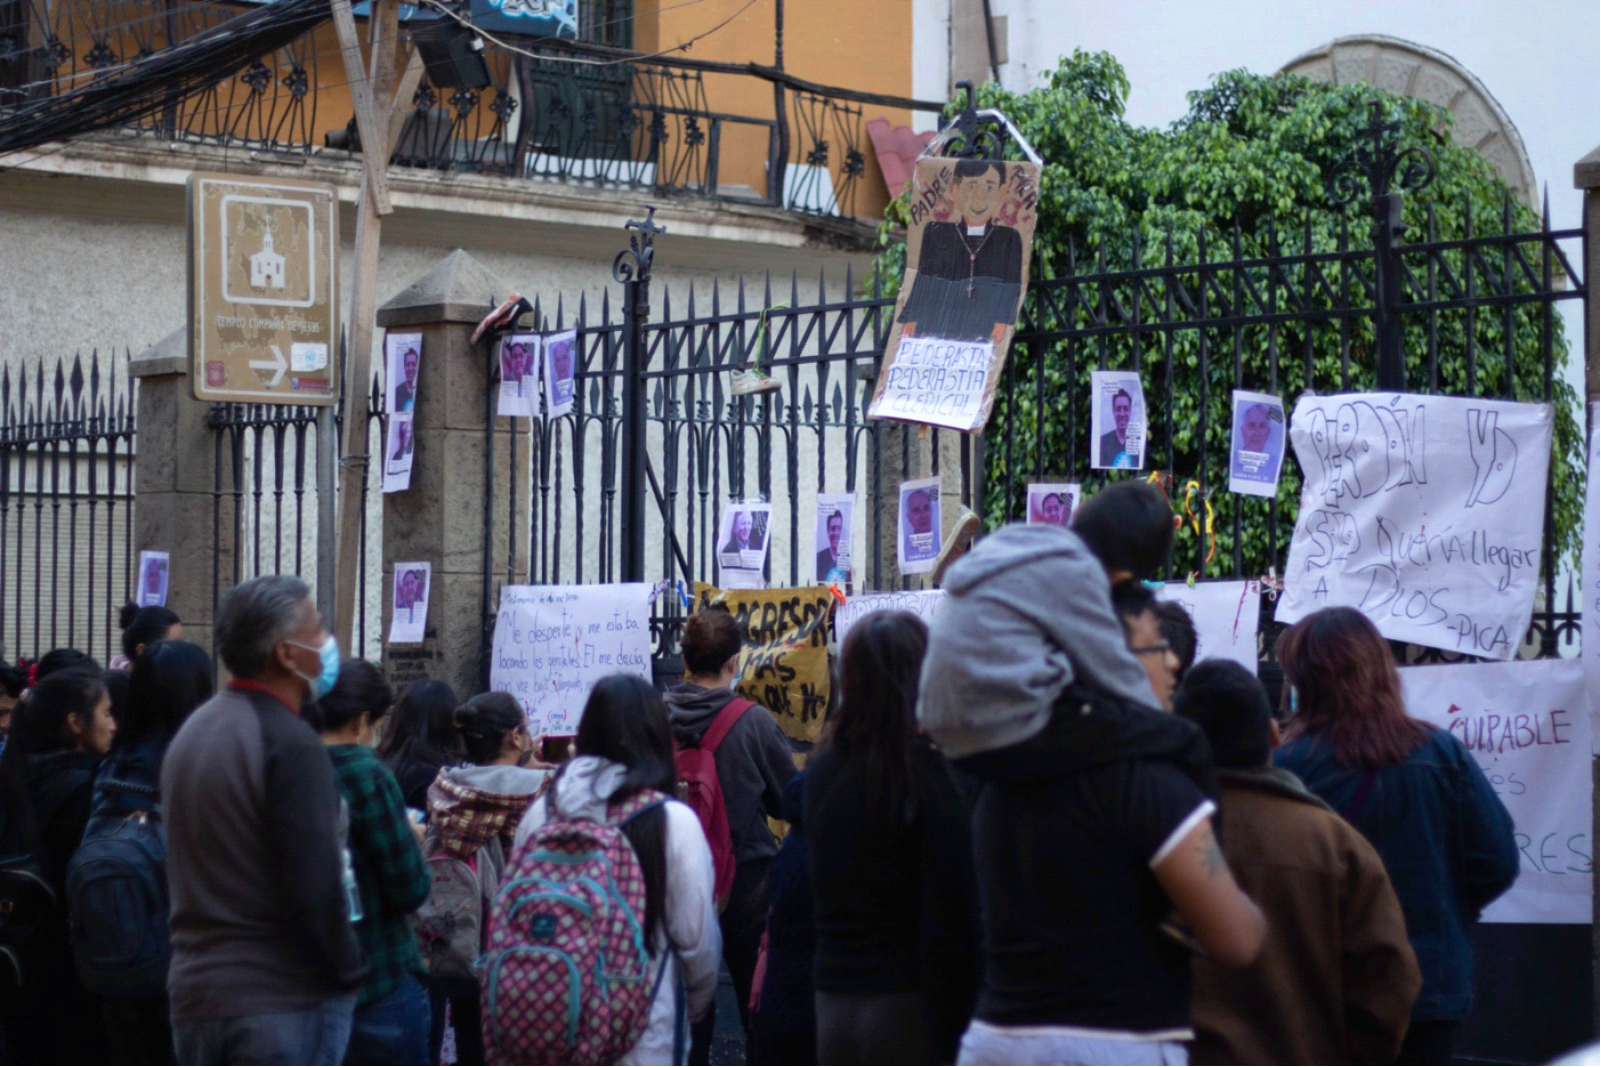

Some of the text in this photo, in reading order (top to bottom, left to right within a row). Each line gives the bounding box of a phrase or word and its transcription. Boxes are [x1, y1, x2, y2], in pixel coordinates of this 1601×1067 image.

[910, 166, 952, 226] PADRE
[898, 341, 986, 368] PEDERASTA
[888, 366, 986, 391] PEDERASTIA
[893, 391, 973, 417] CLERICAL
[1312, 575, 1330, 603] A
[735, 596, 829, 648] AGRESOR
